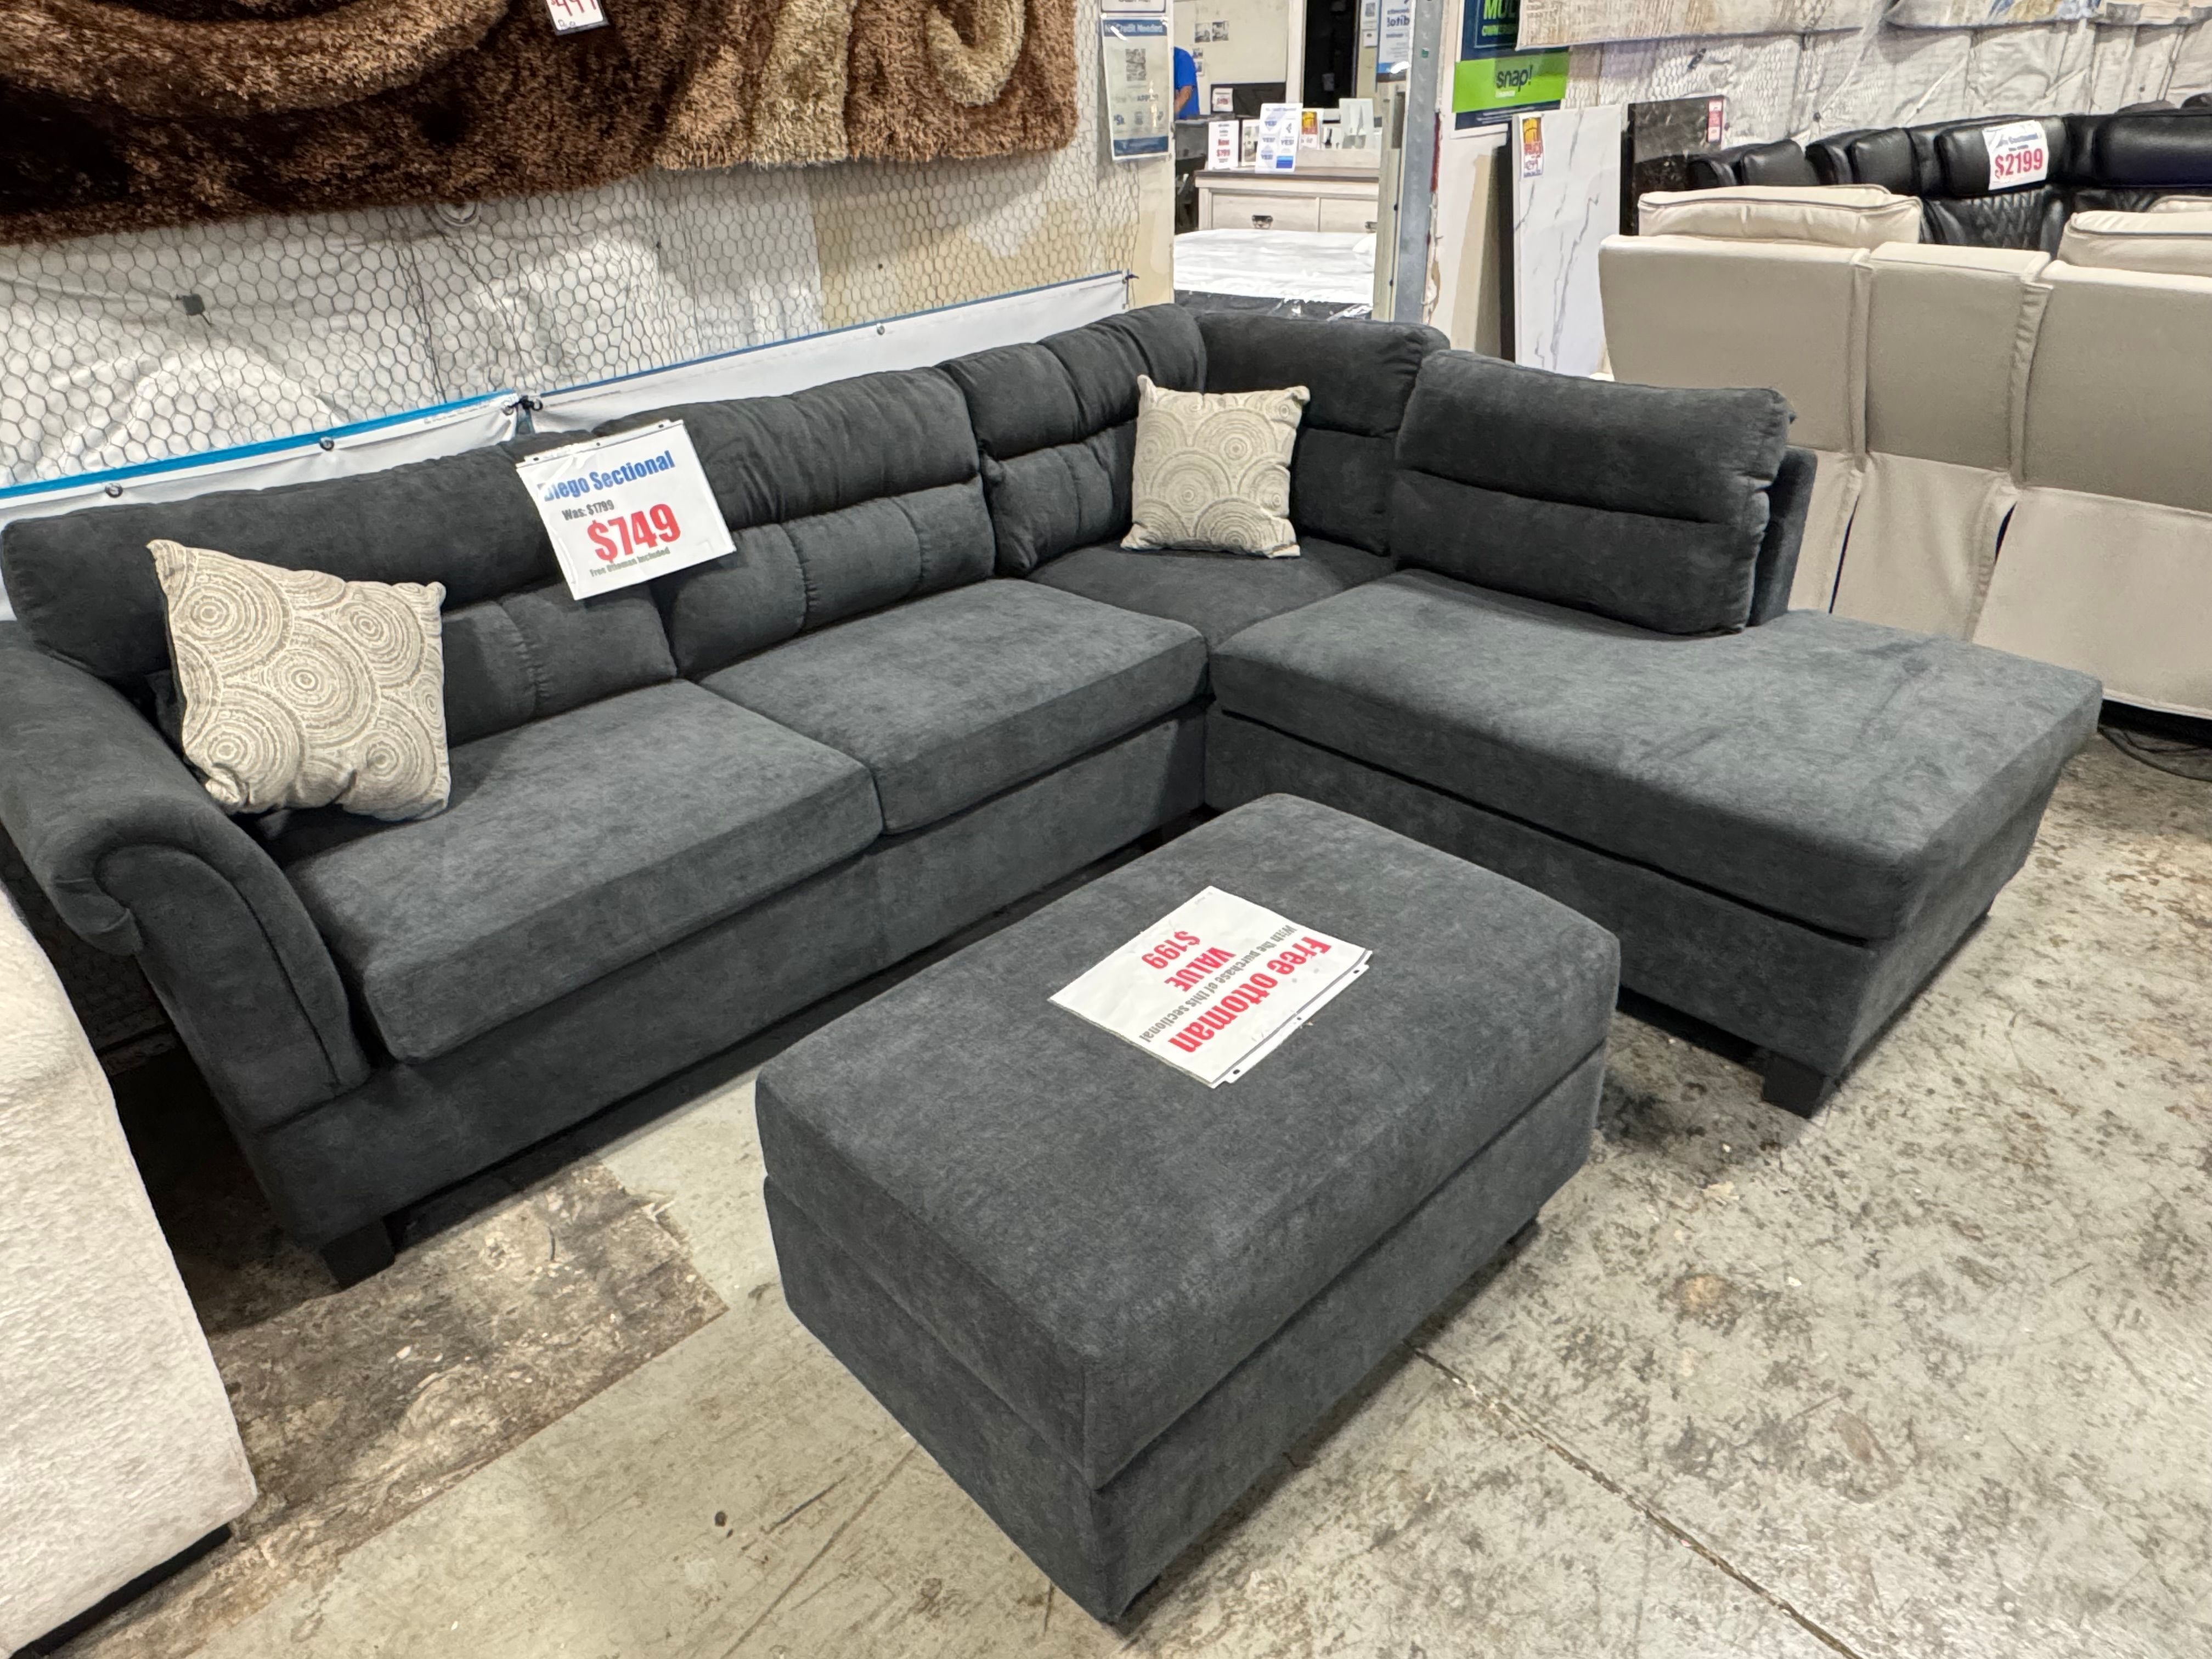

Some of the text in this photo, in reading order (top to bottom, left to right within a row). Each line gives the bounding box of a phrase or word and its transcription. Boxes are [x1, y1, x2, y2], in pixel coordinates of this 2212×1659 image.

[1496, 65, 1533, 92] snap!
[1995, 148, 2043, 180] $2199
[589, 450, 675, 490] Sectional
[562, 499, 614, 521] Was: $1799
[587, 504, 681, 563] $749
[1141, 930, 1200, 969] $199
[1164, 947, 1237, 992] VALUE
[1139, 925, 1297, 1042] With the purchase of this sectional
[1168, 936, 1331, 1052] Free ottoman
